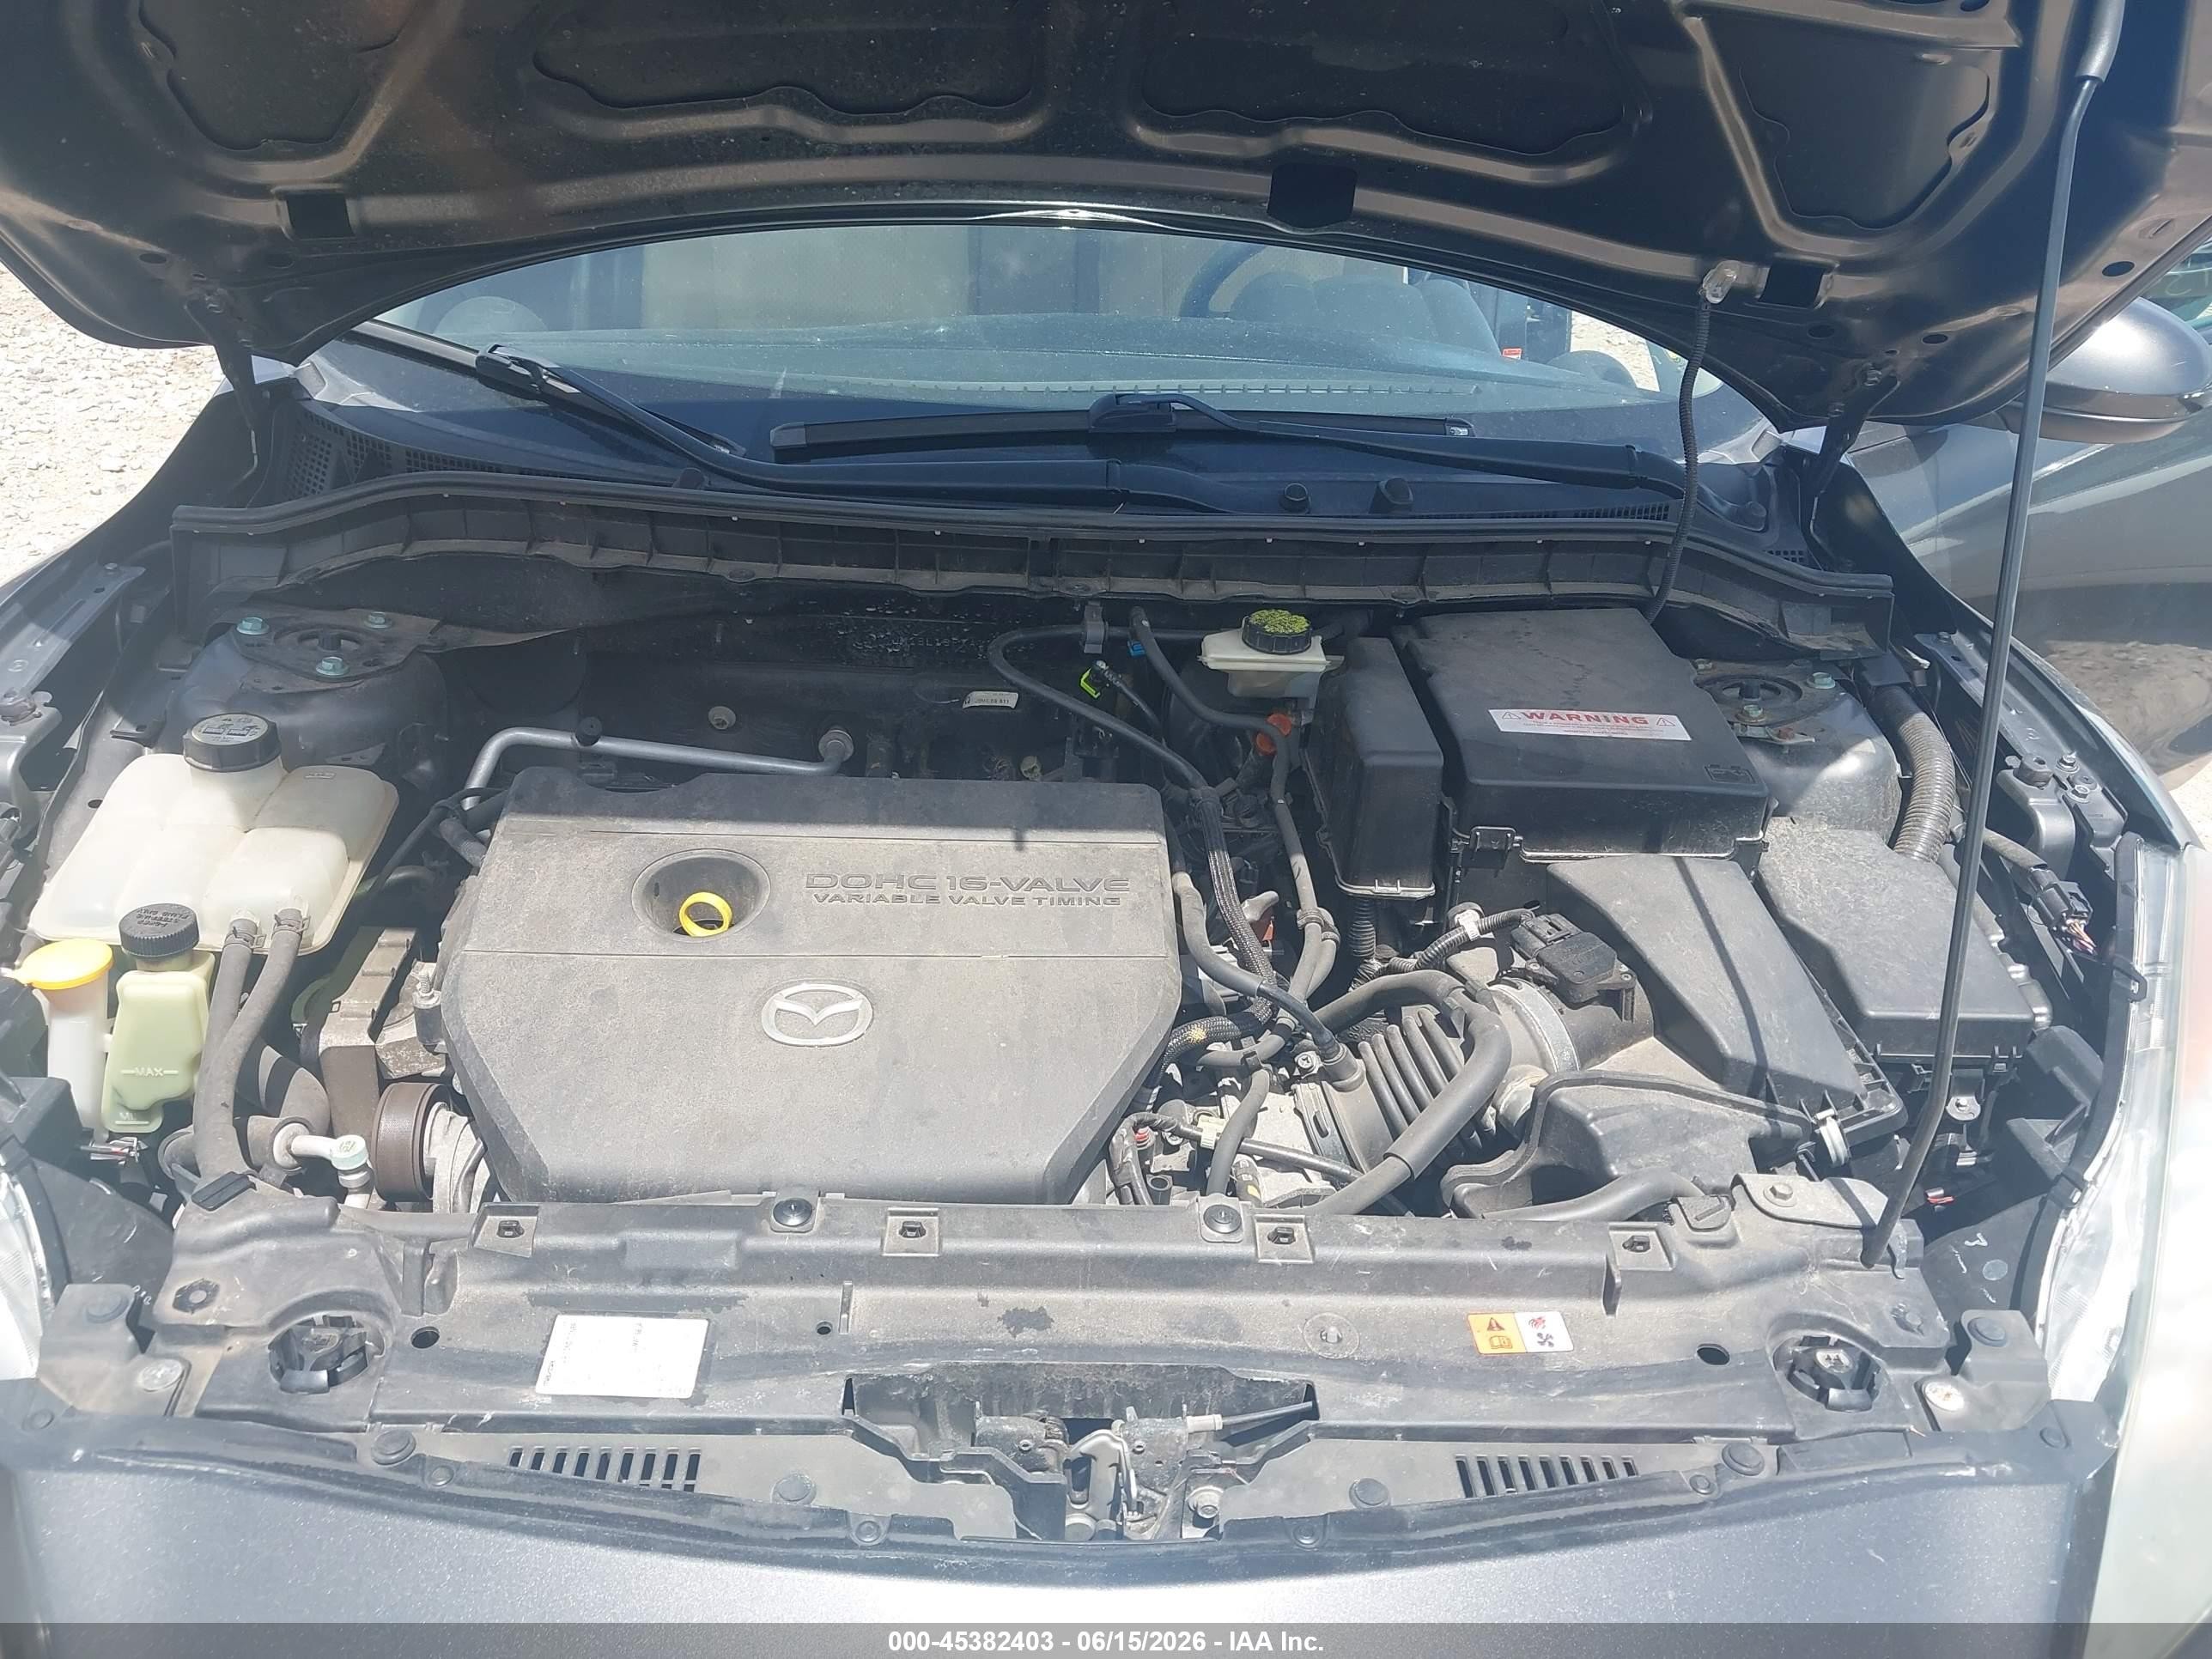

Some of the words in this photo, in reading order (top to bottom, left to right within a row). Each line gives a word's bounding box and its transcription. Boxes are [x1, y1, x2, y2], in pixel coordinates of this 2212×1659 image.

[1521, 711, 1650, 725] WARNING
[805, 873, 937, 890] DOHC
[946, 875, 1130, 892] 16-VALVE
[813, 893, 941, 904] VARIABLE
[948, 895, 1026, 906] VALVE
[1032, 896, 1121, 906] TIMING
[135, 1067, 163, 1077] MAX
